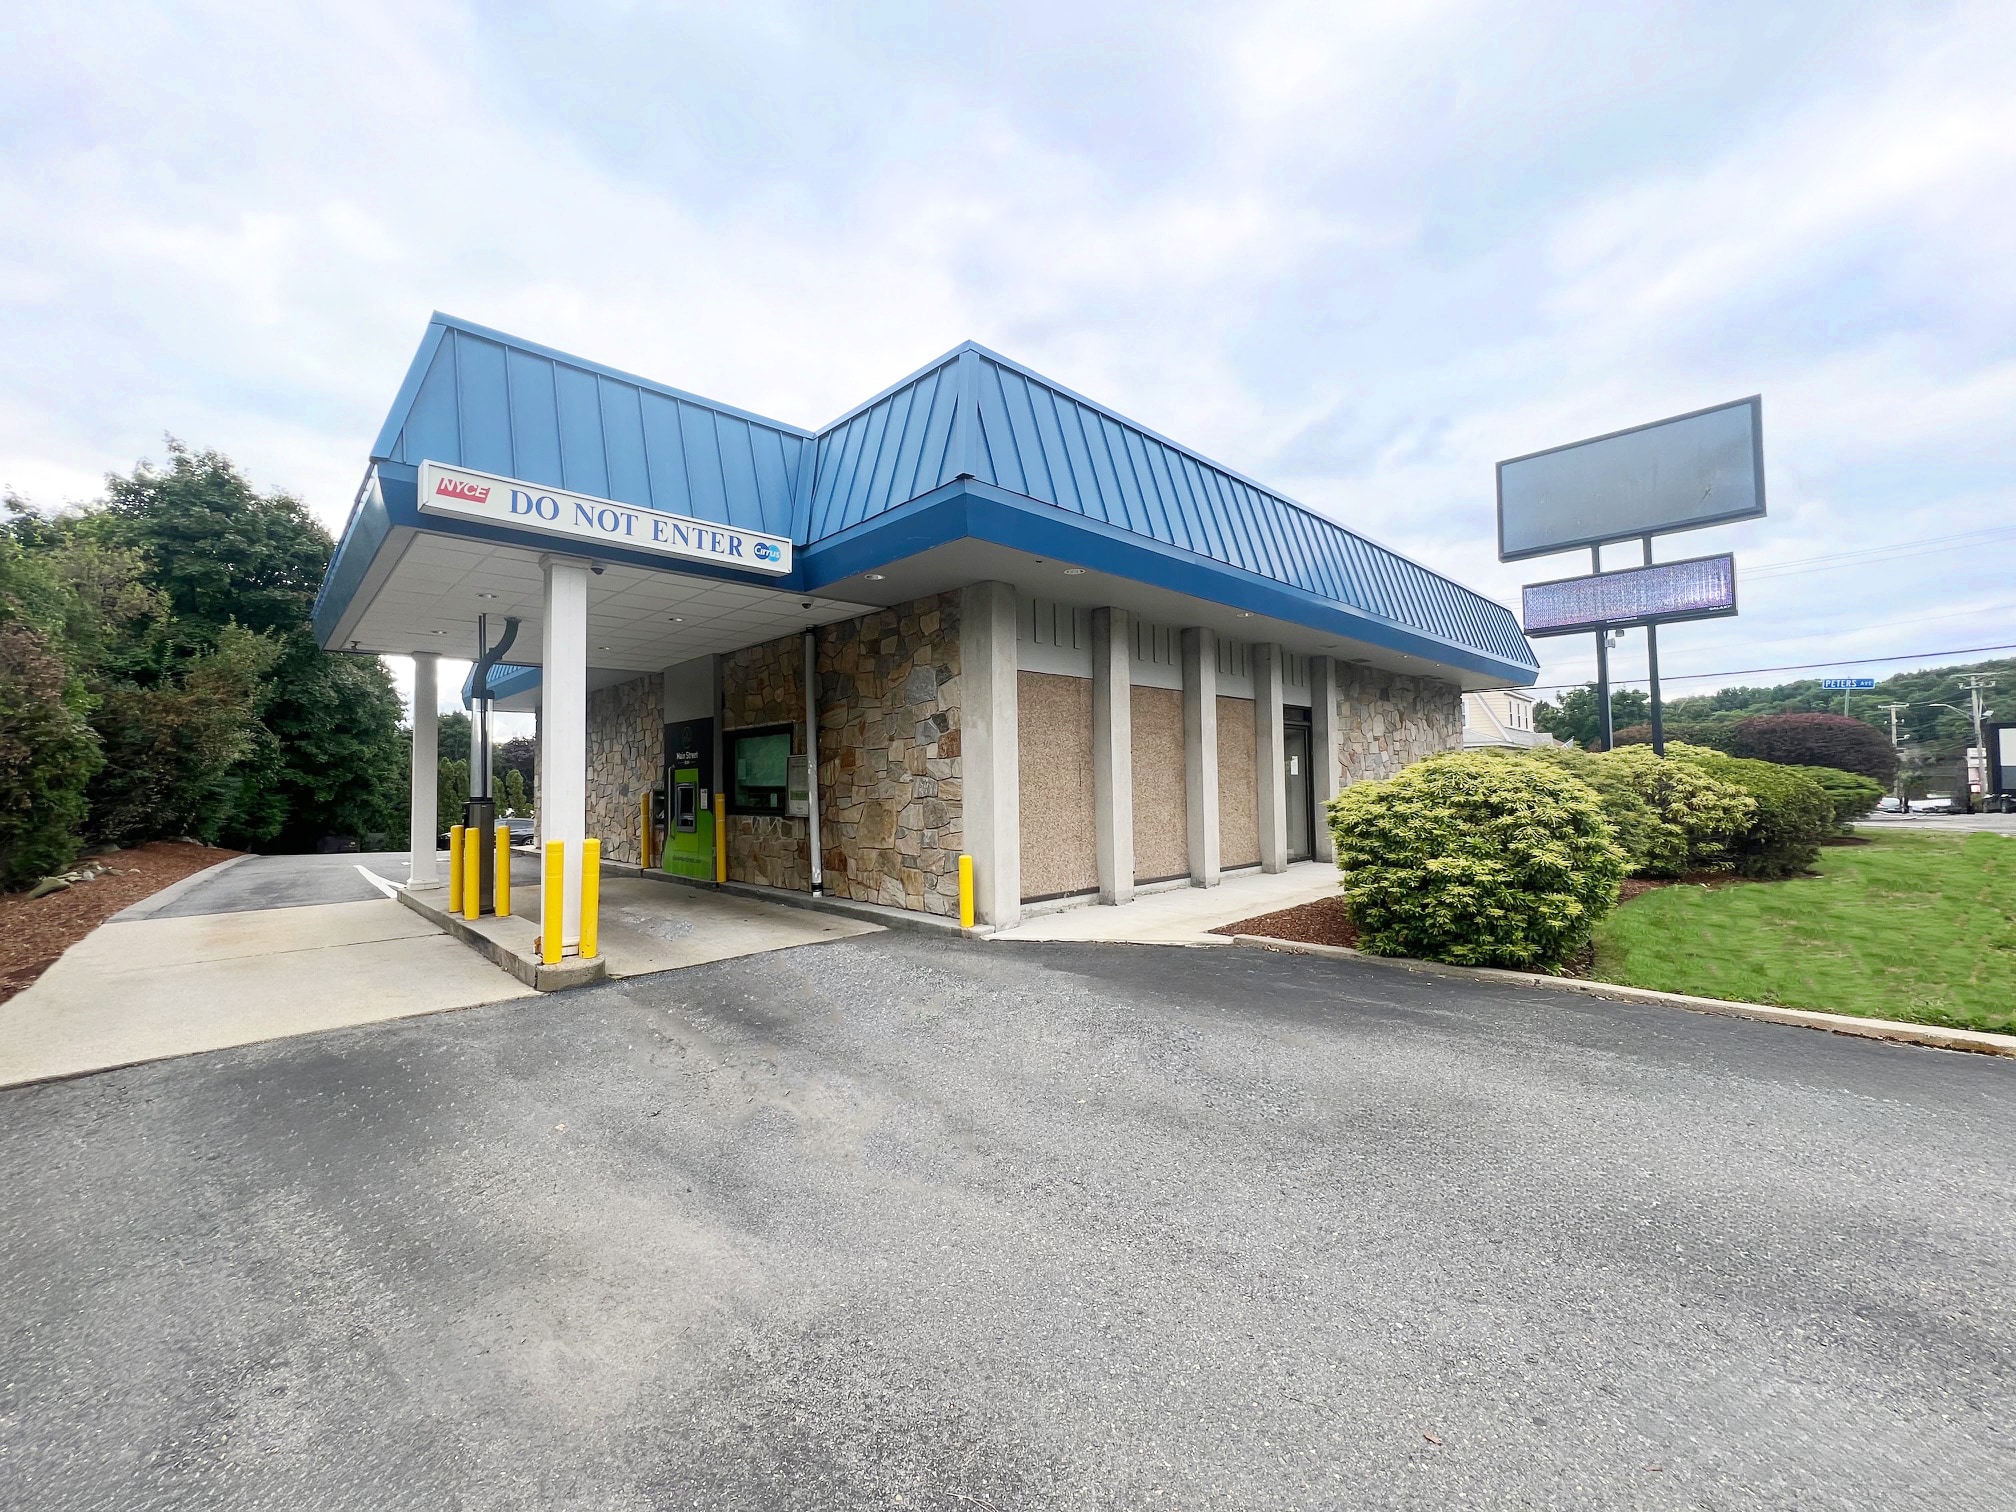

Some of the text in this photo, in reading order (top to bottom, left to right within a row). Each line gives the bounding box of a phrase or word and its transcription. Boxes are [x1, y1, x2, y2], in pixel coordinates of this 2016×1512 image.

[440, 478, 488, 498] NYCE
[509, 489, 743, 558] DO NOT ENTER
[755, 545, 780, 559] Cirrus
[1825, 679, 1857, 688] PETERS
